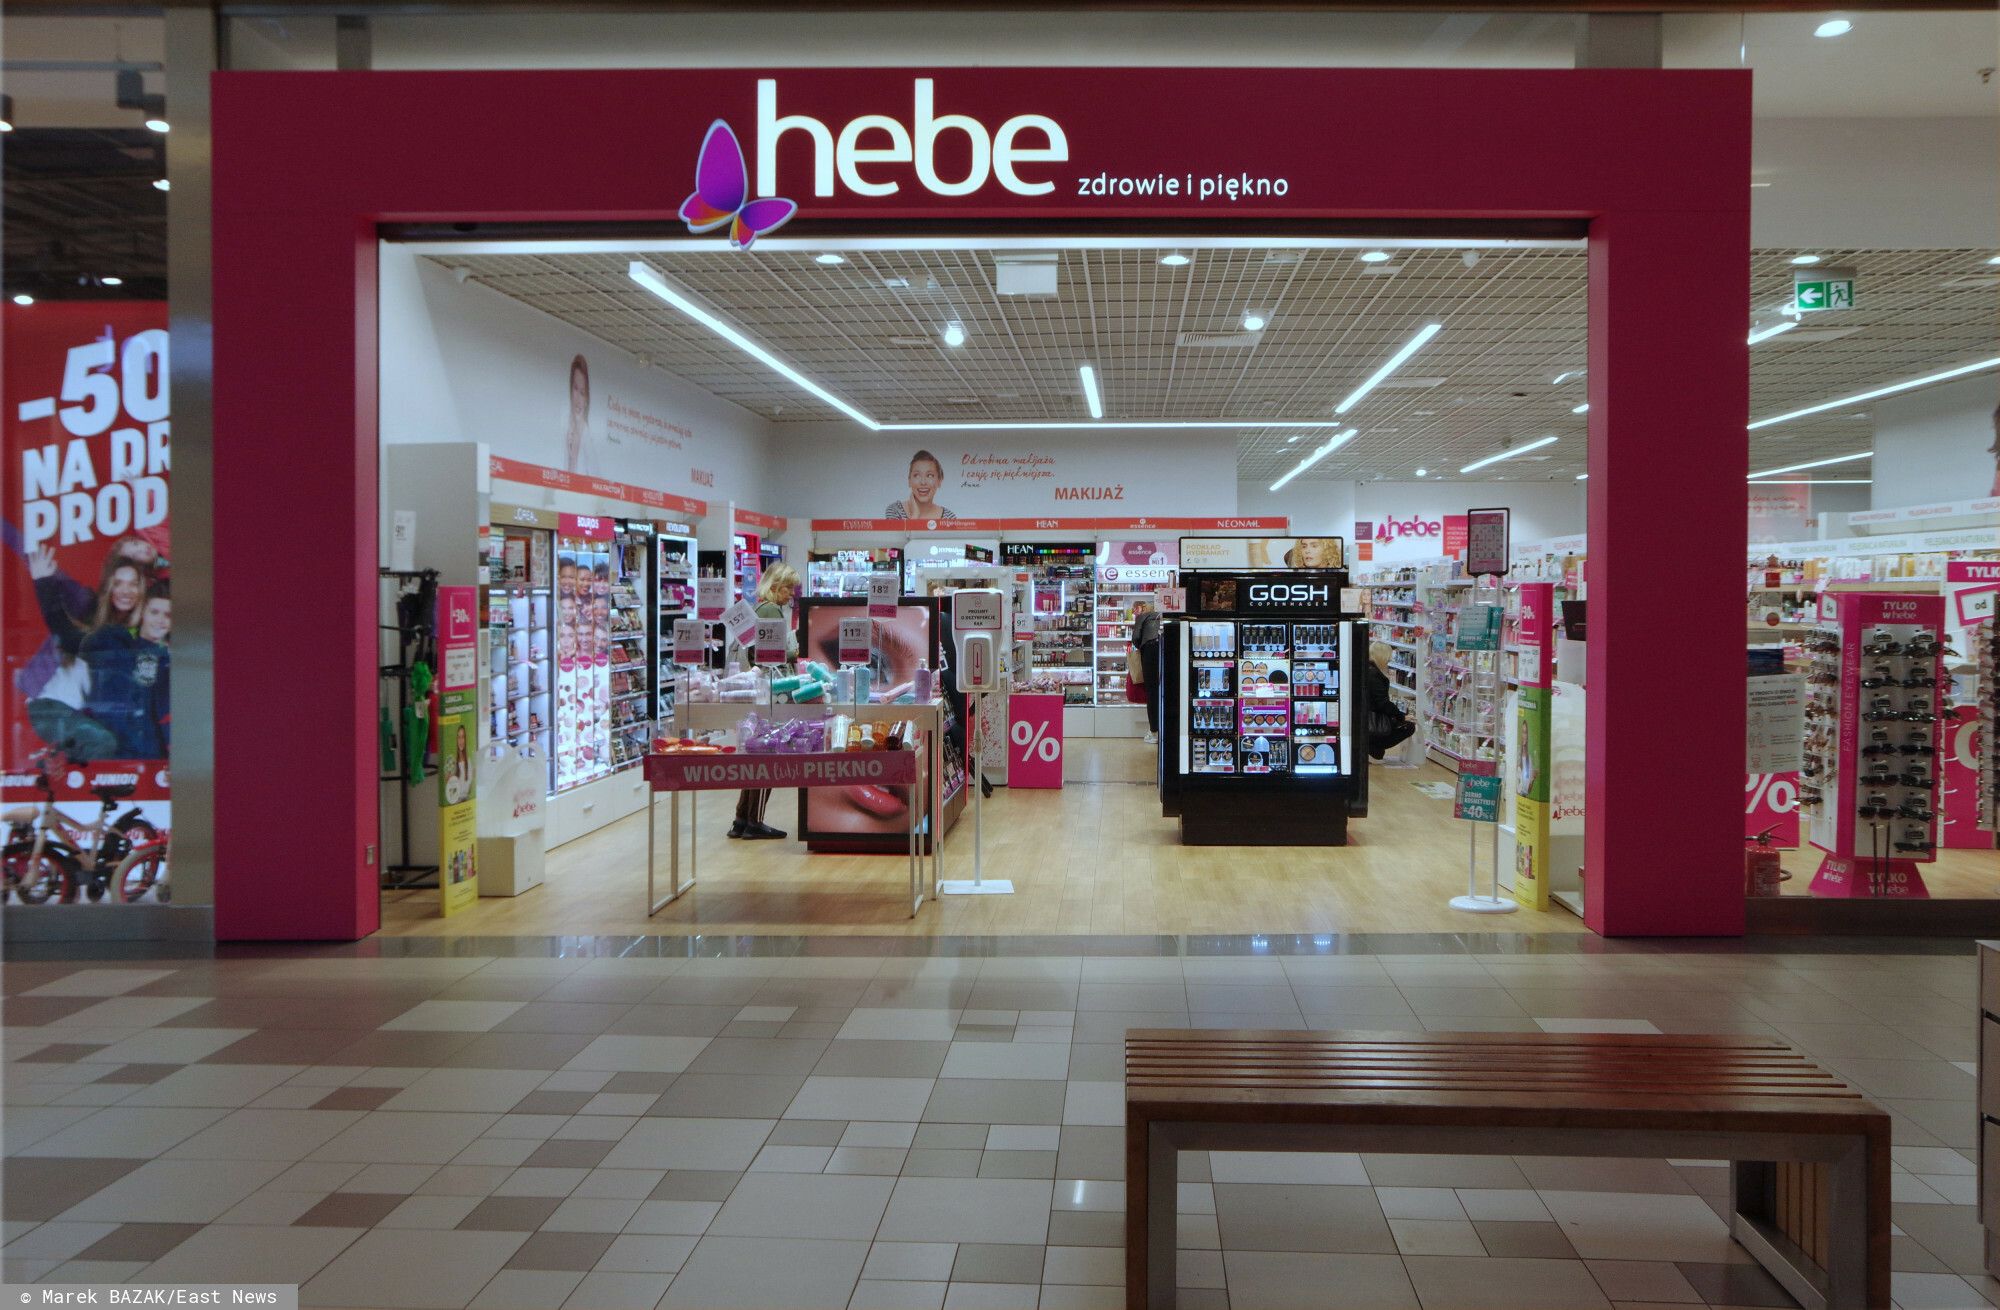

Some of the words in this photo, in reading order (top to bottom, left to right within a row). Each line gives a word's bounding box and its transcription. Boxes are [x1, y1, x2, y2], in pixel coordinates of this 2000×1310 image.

[757, 77, 1069, 198] hebe
[1078, 172, 1180, 196] zdrowie
[1186, 173, 1193, 196] i
[1199, 172, 1289, 201] piękno
[961, 453, 1009, 465] Odrobina
[22, 438, 98, 502] NA
[1054, 484, 1124, 500] MAKIJAŻ
[23, 475, 169, 555] PROD
[1036, 520, 1059, 528] HEAN
[1387, 515, 1442, 537] hebe
[1007, 545, 1034, 554] HEAN
[1249, 584, 1329, 602] GOSH
[1883, 601, 1917, 610] TYLKO
[1891, 611, 1917, 620] hebe
[90, 773, 140, 786] JUNIOR
[683, 764, 770, 783] WIOSNA
[803, 760, 884, 783] PIĘKNO
[1471, 779, 1491, 788] hebe
